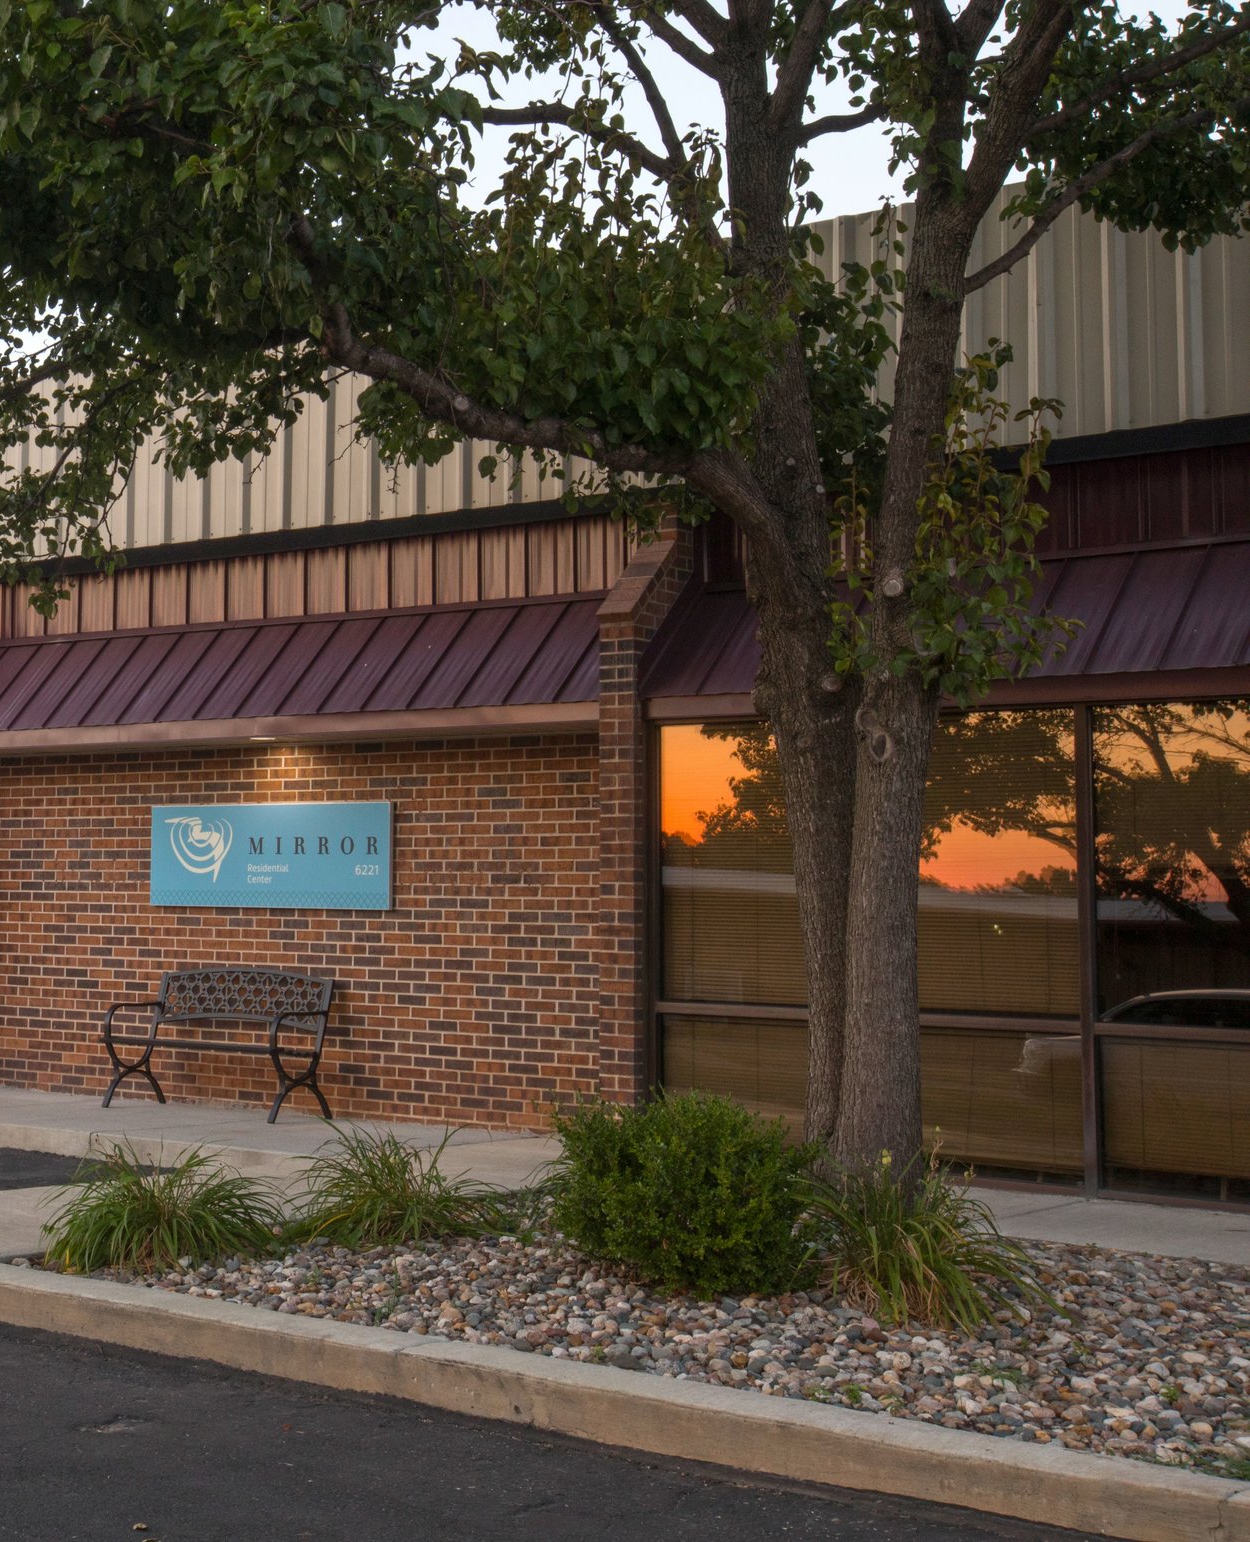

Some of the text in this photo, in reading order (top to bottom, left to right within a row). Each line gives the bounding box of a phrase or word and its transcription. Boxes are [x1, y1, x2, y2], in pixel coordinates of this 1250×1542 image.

[248, 836, 379, 856] MIRROR
[247, 863, 289, 874] Residential
[354, 865, 380, 876] 6221
[247, 874, 273, 884] Center
